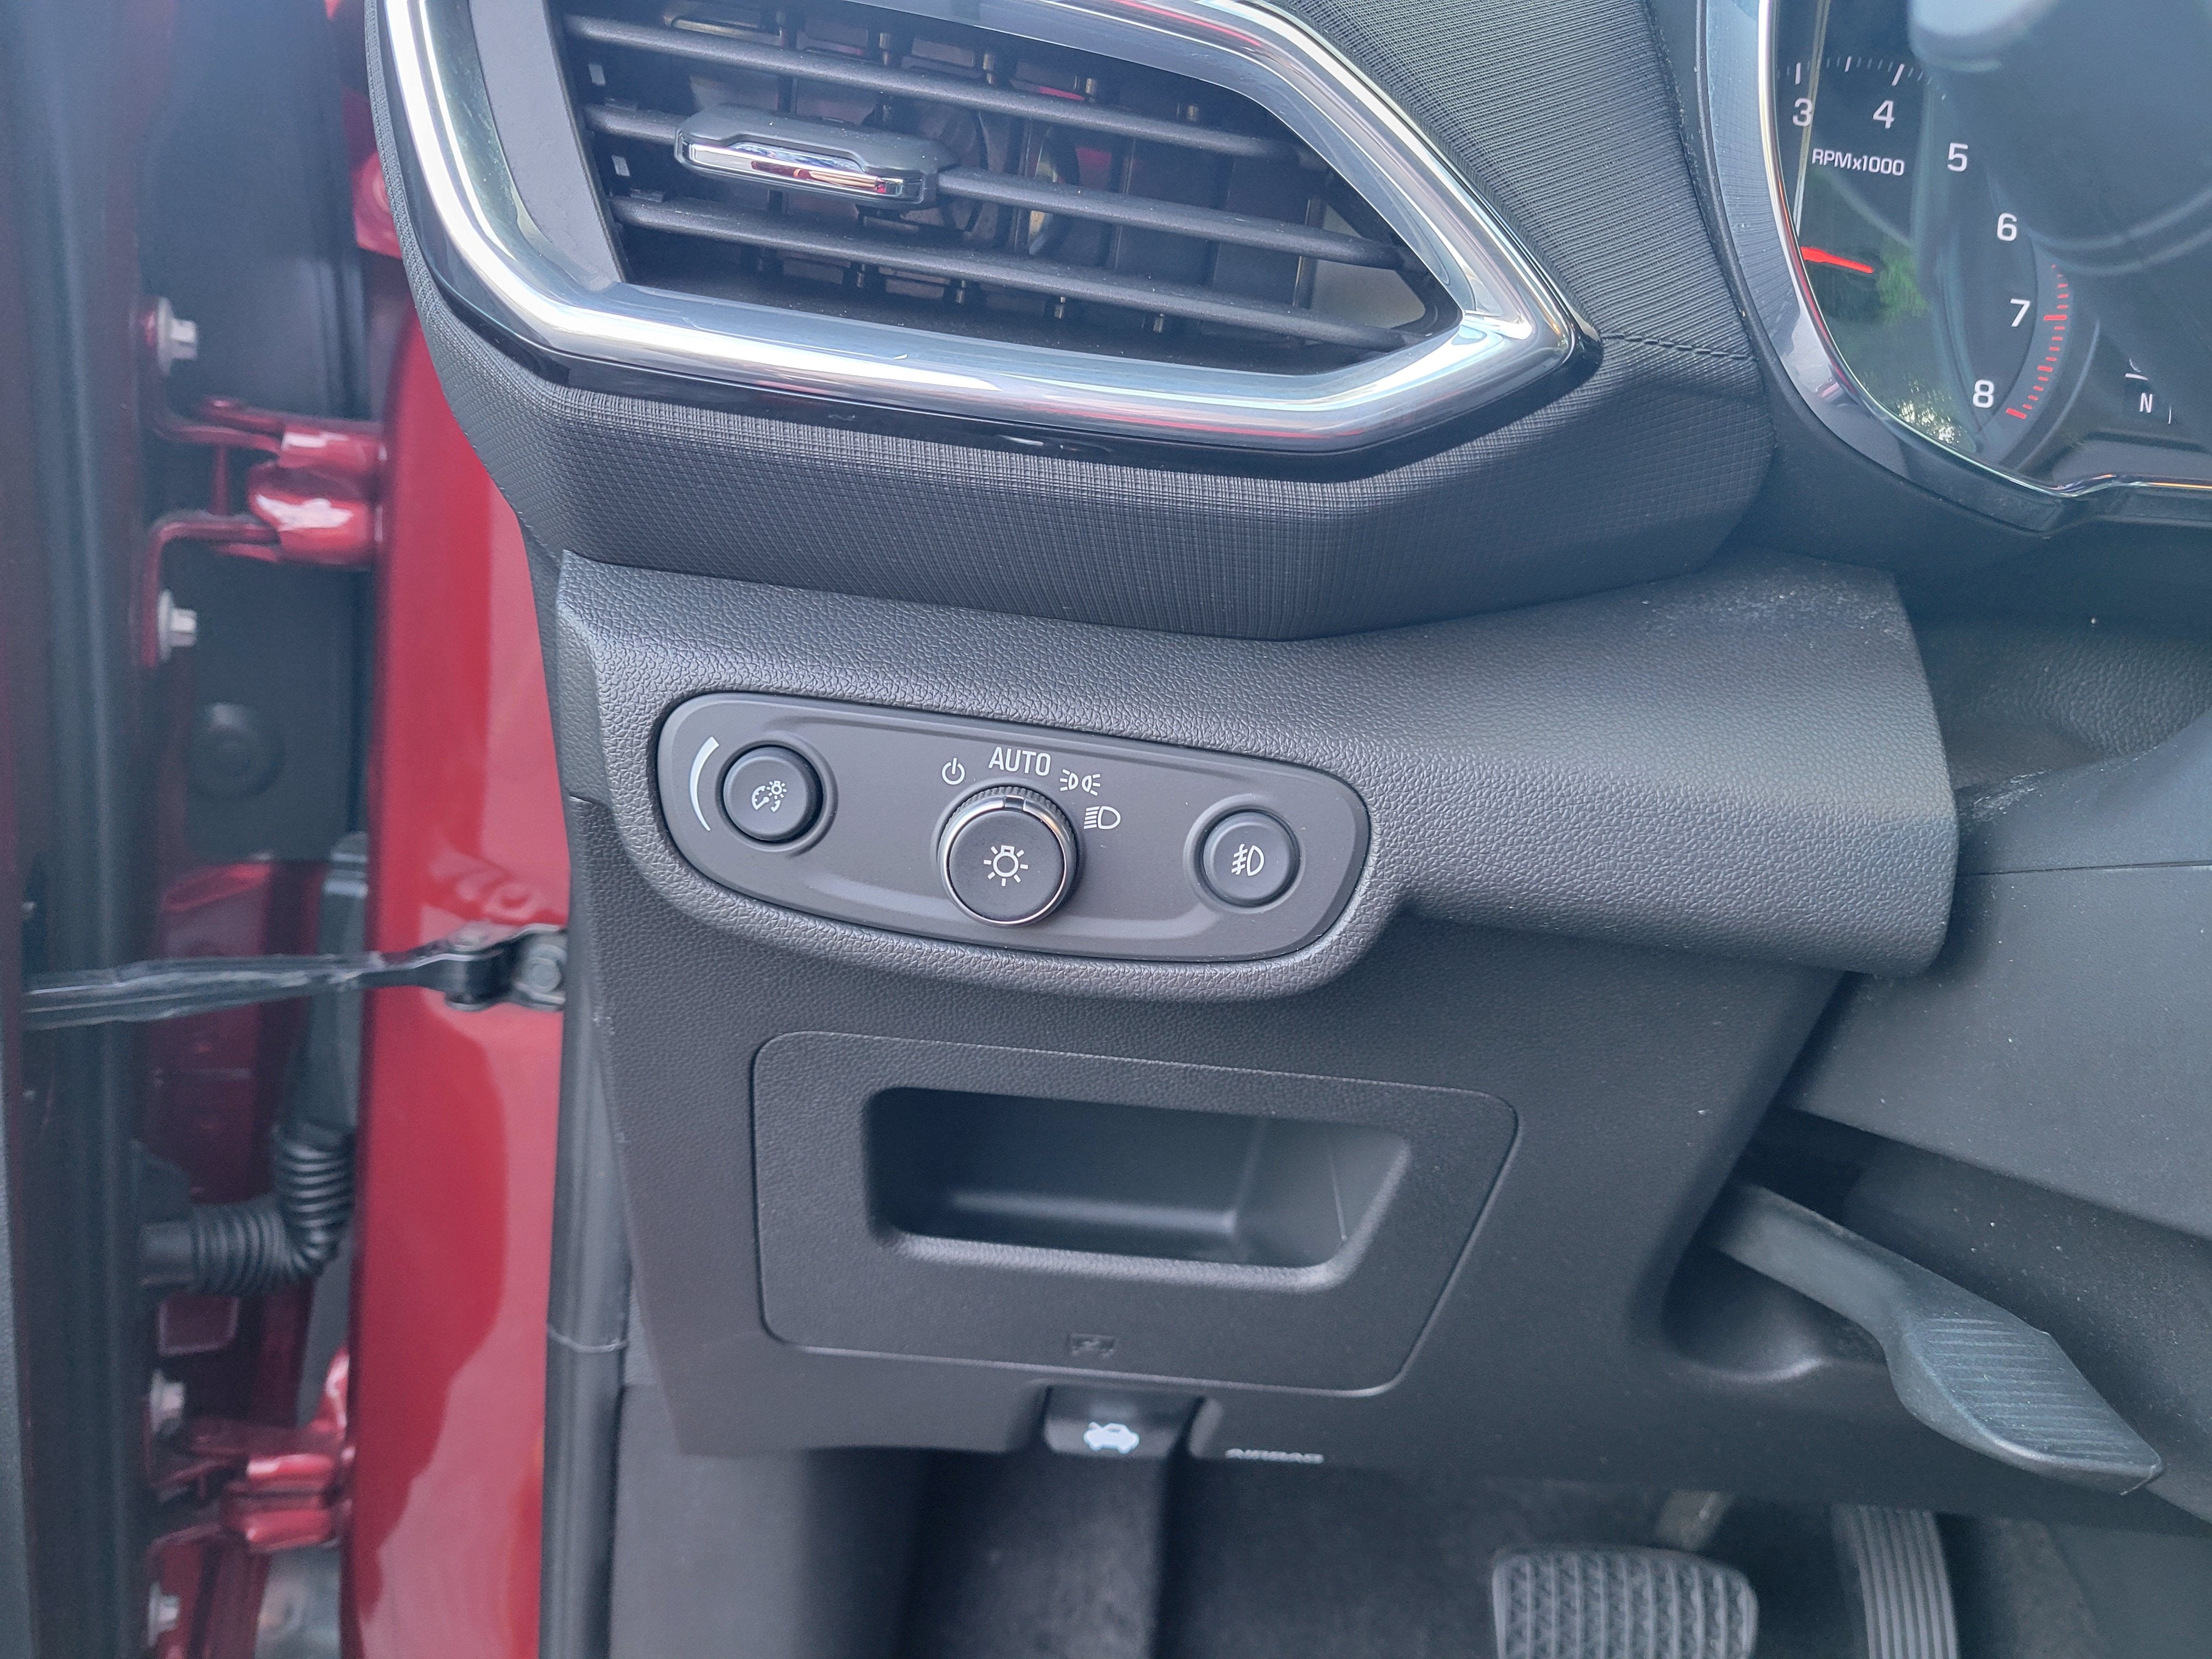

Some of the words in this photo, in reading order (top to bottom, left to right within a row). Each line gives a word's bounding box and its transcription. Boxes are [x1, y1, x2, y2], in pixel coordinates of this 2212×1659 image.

[1792, 97, 1813, 127] 3
[1872, 99, 1895, 129] 4
[1812, 148, 1905, 176] RPMx1000
[1947, 142, 1969, 172] 5
[1997, 213, 2017, 241] 6
[2010, 298, 2030, 328] 7
[1973, 379, 1994, 409] 8
[2140, 392, 2153, 413] N
[988, 746, 1052, 776] AUTO
